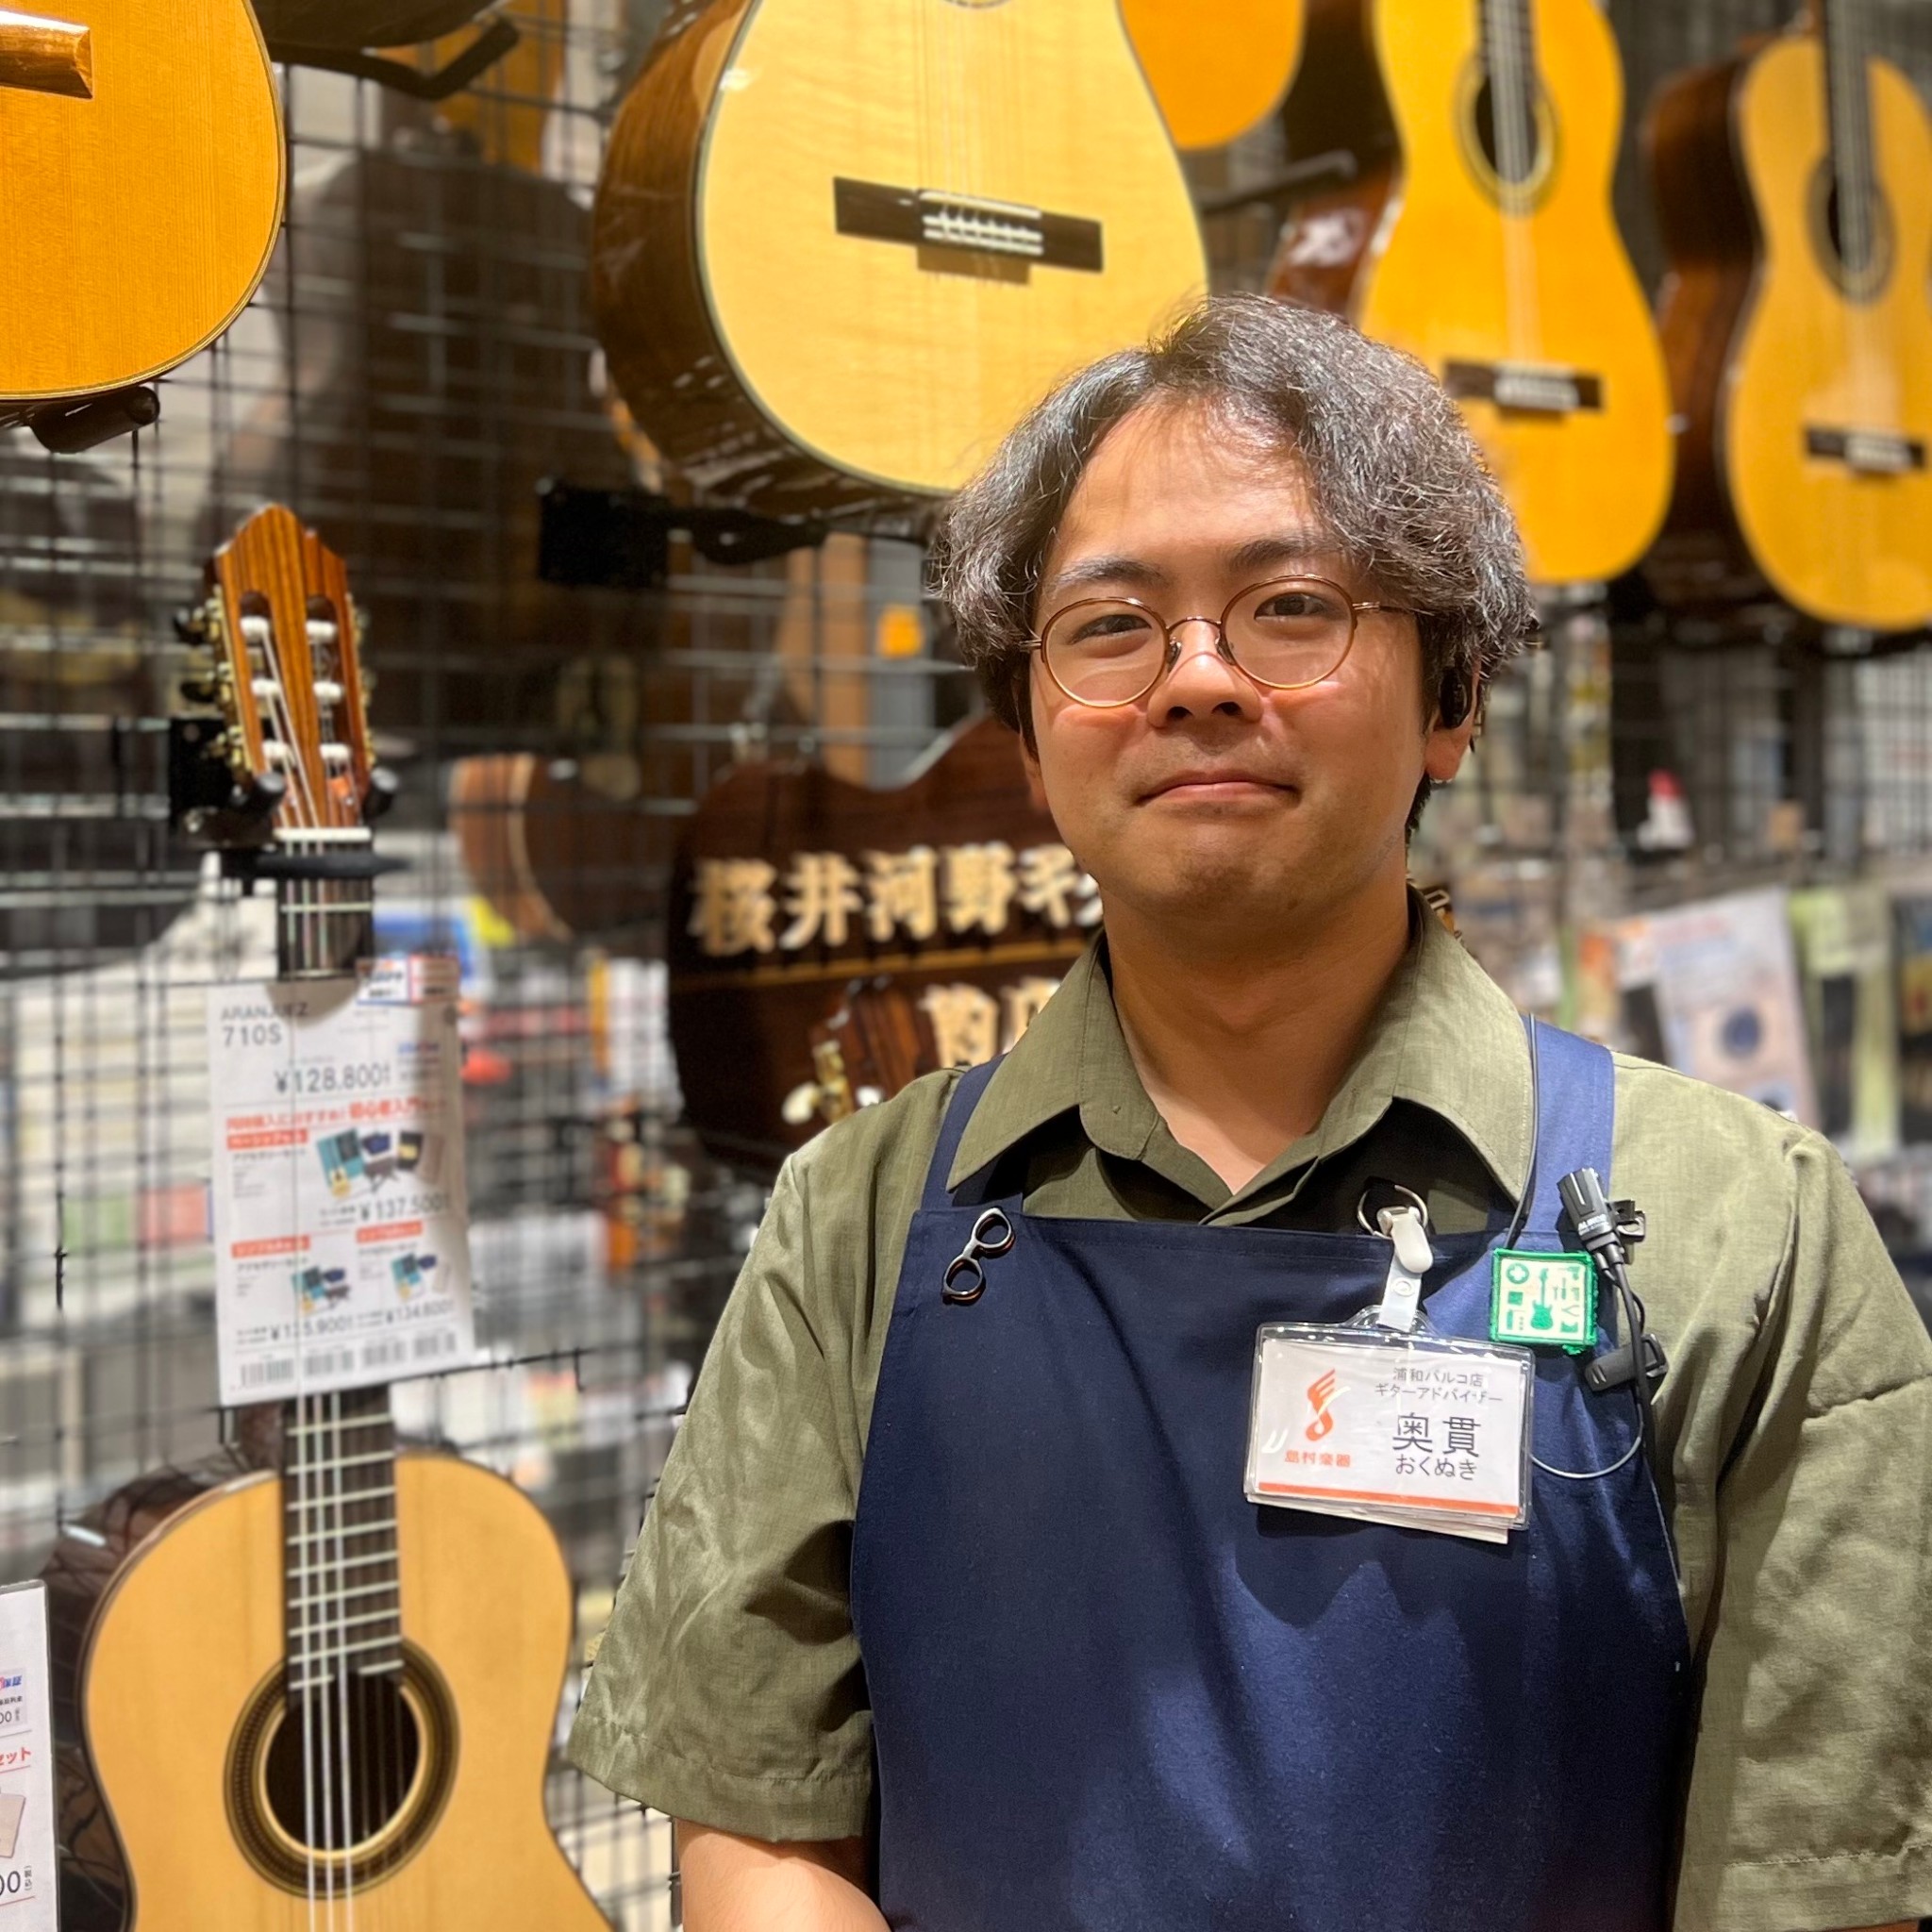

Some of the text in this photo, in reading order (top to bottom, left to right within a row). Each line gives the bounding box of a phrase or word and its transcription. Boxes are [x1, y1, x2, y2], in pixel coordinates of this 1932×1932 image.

[222, 1024, 282, 1047] 710S
[1392, 1368, 1484, 1388] 浦和パルコ店
[1392, 1412, 1481, 1457] 奥貫
[1395, 1455, 1477, 1481] おくぬき
